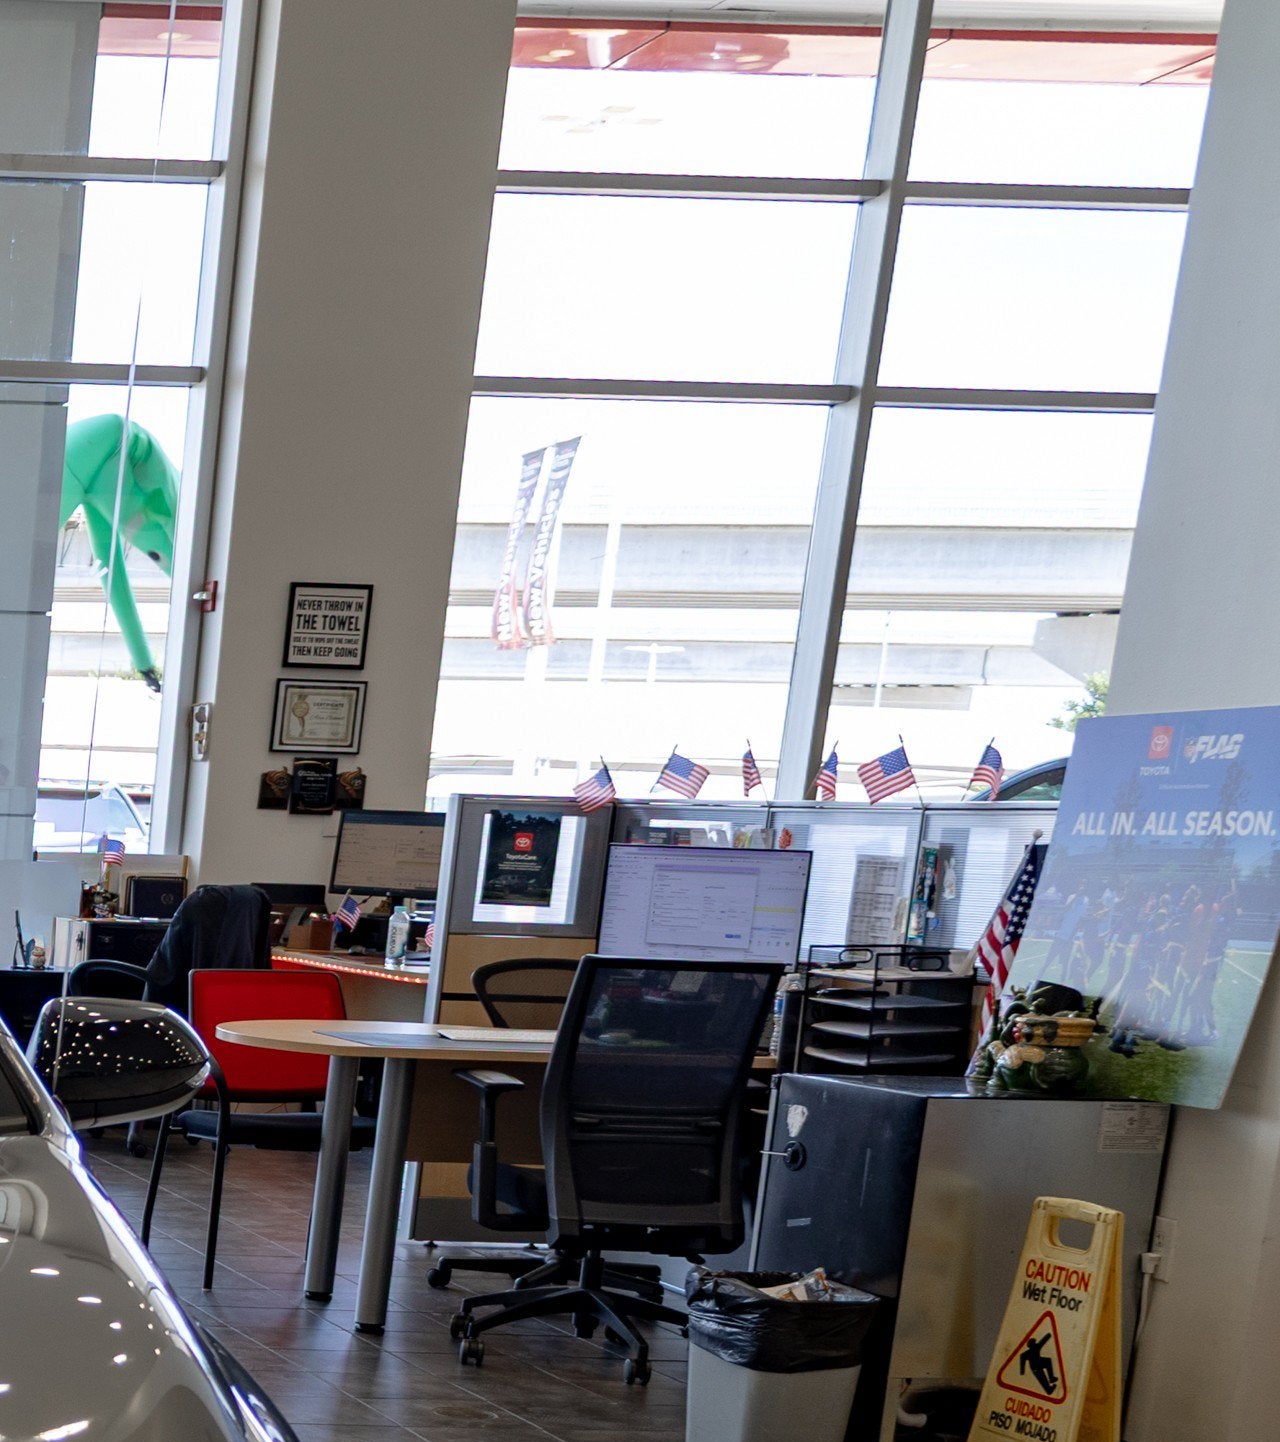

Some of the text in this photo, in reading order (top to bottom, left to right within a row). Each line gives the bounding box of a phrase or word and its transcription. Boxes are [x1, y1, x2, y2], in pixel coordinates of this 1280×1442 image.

[296, 599, 364, 612] NEVER THROW IN
[529, 588, 545, 636] New
[296, 614, 361, 631] THE TOWEL
[292, 645, 358, 658] THEN KEEP GOING
[1140, 766, 1170, 776] TOYOTA
[1071, 811, 1276, 836] ALL IN. ALL SEASON.
[1025, 1259, 1091, 1292] CAUTION
[1022, 1281, 1082, 1312] Wet Floor
[989, 1410, 1012, 1430] PISO
[1005, 1397, 1051, 1423] CUIDADO
